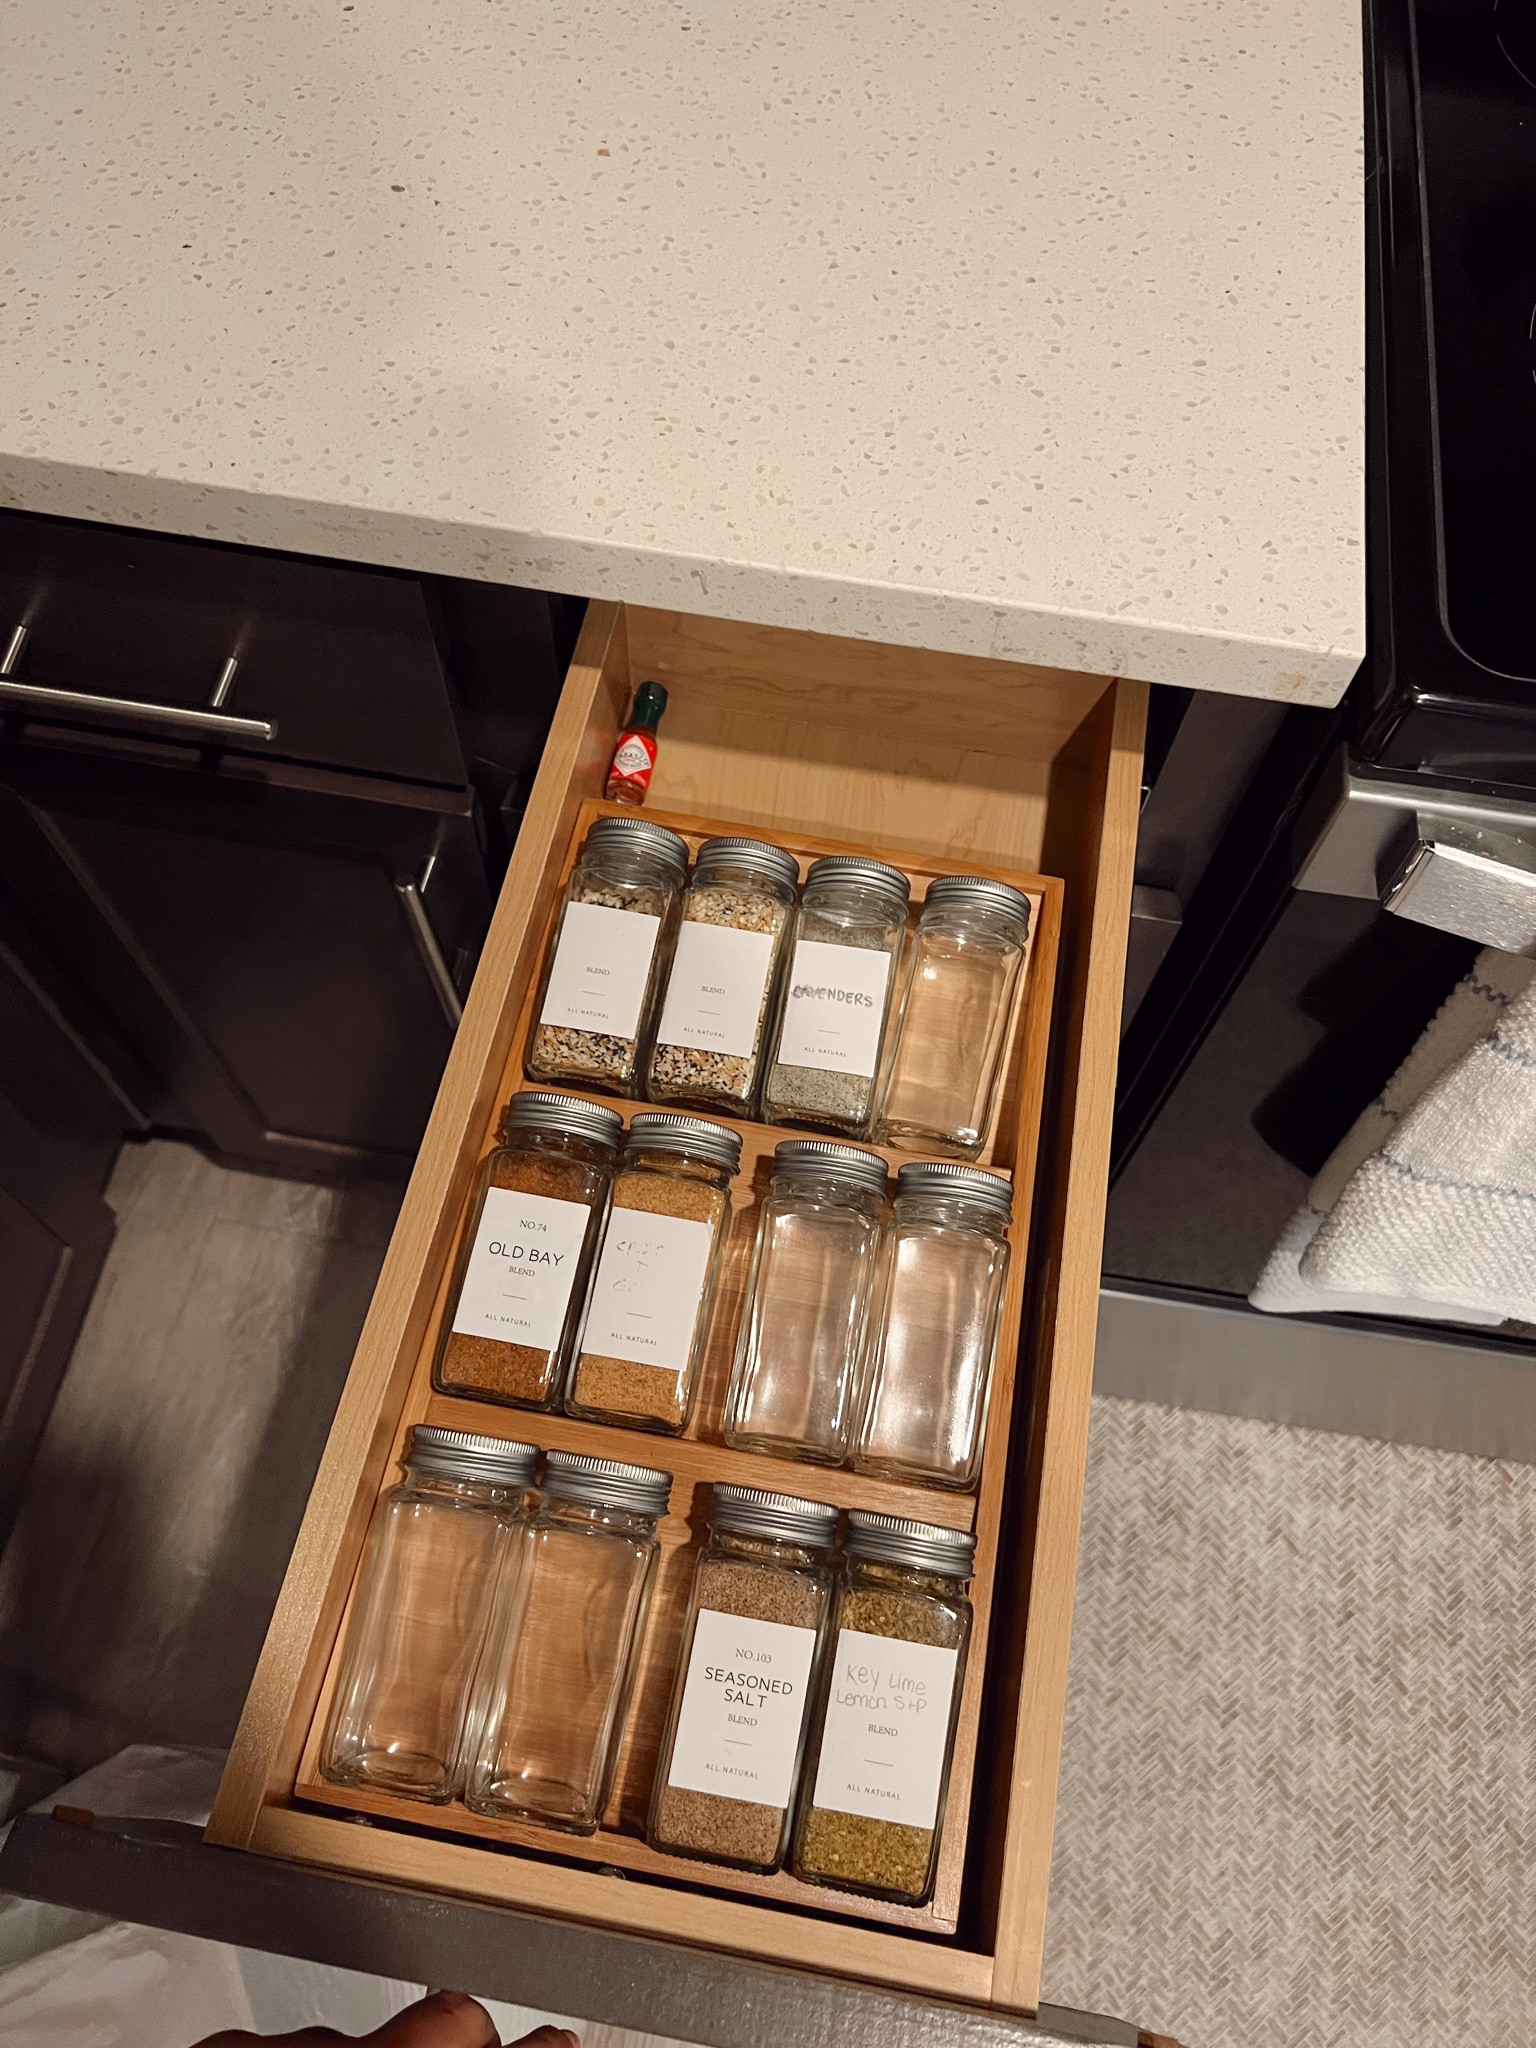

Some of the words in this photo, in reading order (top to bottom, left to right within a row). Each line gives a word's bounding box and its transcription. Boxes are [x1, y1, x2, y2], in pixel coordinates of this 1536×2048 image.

[586, 966, 610, 975] BLEND
[701, 985, 725, 995] BLEND
[567, 1007, 578, 1015] ALL
[581, 1010, 609, 1019] NATURAL
[697, 1029, 725, 1038] NATURAL
[818, 1048, 847, 1057] NATURAL
[519, 1220, 547, 1232] NO.74
[489, 1241, 524, 1259] OLD
[528, 1249, 565, 1266] BAY
[508, 1266, 535, 1277] BLEND
[485, 1313, 498, 1321] ALL
[500, 1316, 532, 1328] NATURAL
[611, 1332, 624, 1340] ALL
[626, 1335, 658, 1346] NATURAL
[735, 1648, 772, 1663] NO.103
[704, 1667, 793, 1695] SEASONED
[723, 1688, 768, 1708] SALT
[836, 1689, 887, 1710] Lemon
[727, 1713, 758, 1727] BLEND
[868, 1723, 898, 1737] BLEND
[705, 1762, 720, 1772] ALL
[722, 1765, 759, 1780] NATURAL
[846, 1783, 861, 1793] ALL
[864, 1786, 901, 1800] NATURAL
